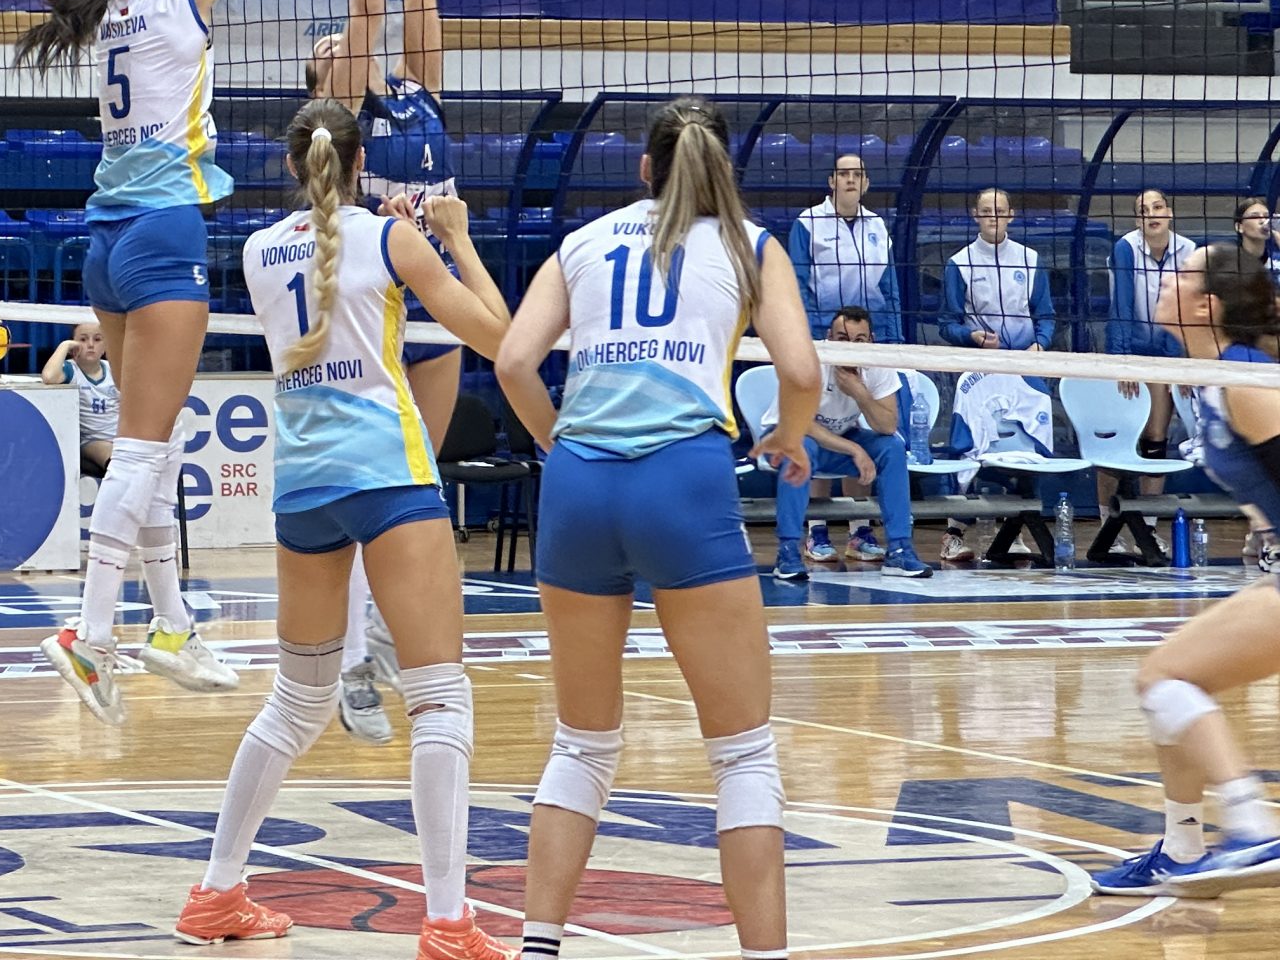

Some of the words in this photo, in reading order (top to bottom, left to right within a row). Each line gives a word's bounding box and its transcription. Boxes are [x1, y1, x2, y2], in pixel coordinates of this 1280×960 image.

[100, 14, 147, 41] VASILEVA
[108, 45, 130, 119] 5
[105, 127, 136, 147] ERCEG
[422, 143, 434, 171] 4
[604, 243, 685, 330] 10
[287, 272, 309, 337] 1
[594, 339, 658, 364] HERCEG
[663, 340, 705, 365] NOVI
[327, 359, 362, 381] NOVI
[221, 463, 257, 478] SRC
[221, 482, 259, 497] BAR
